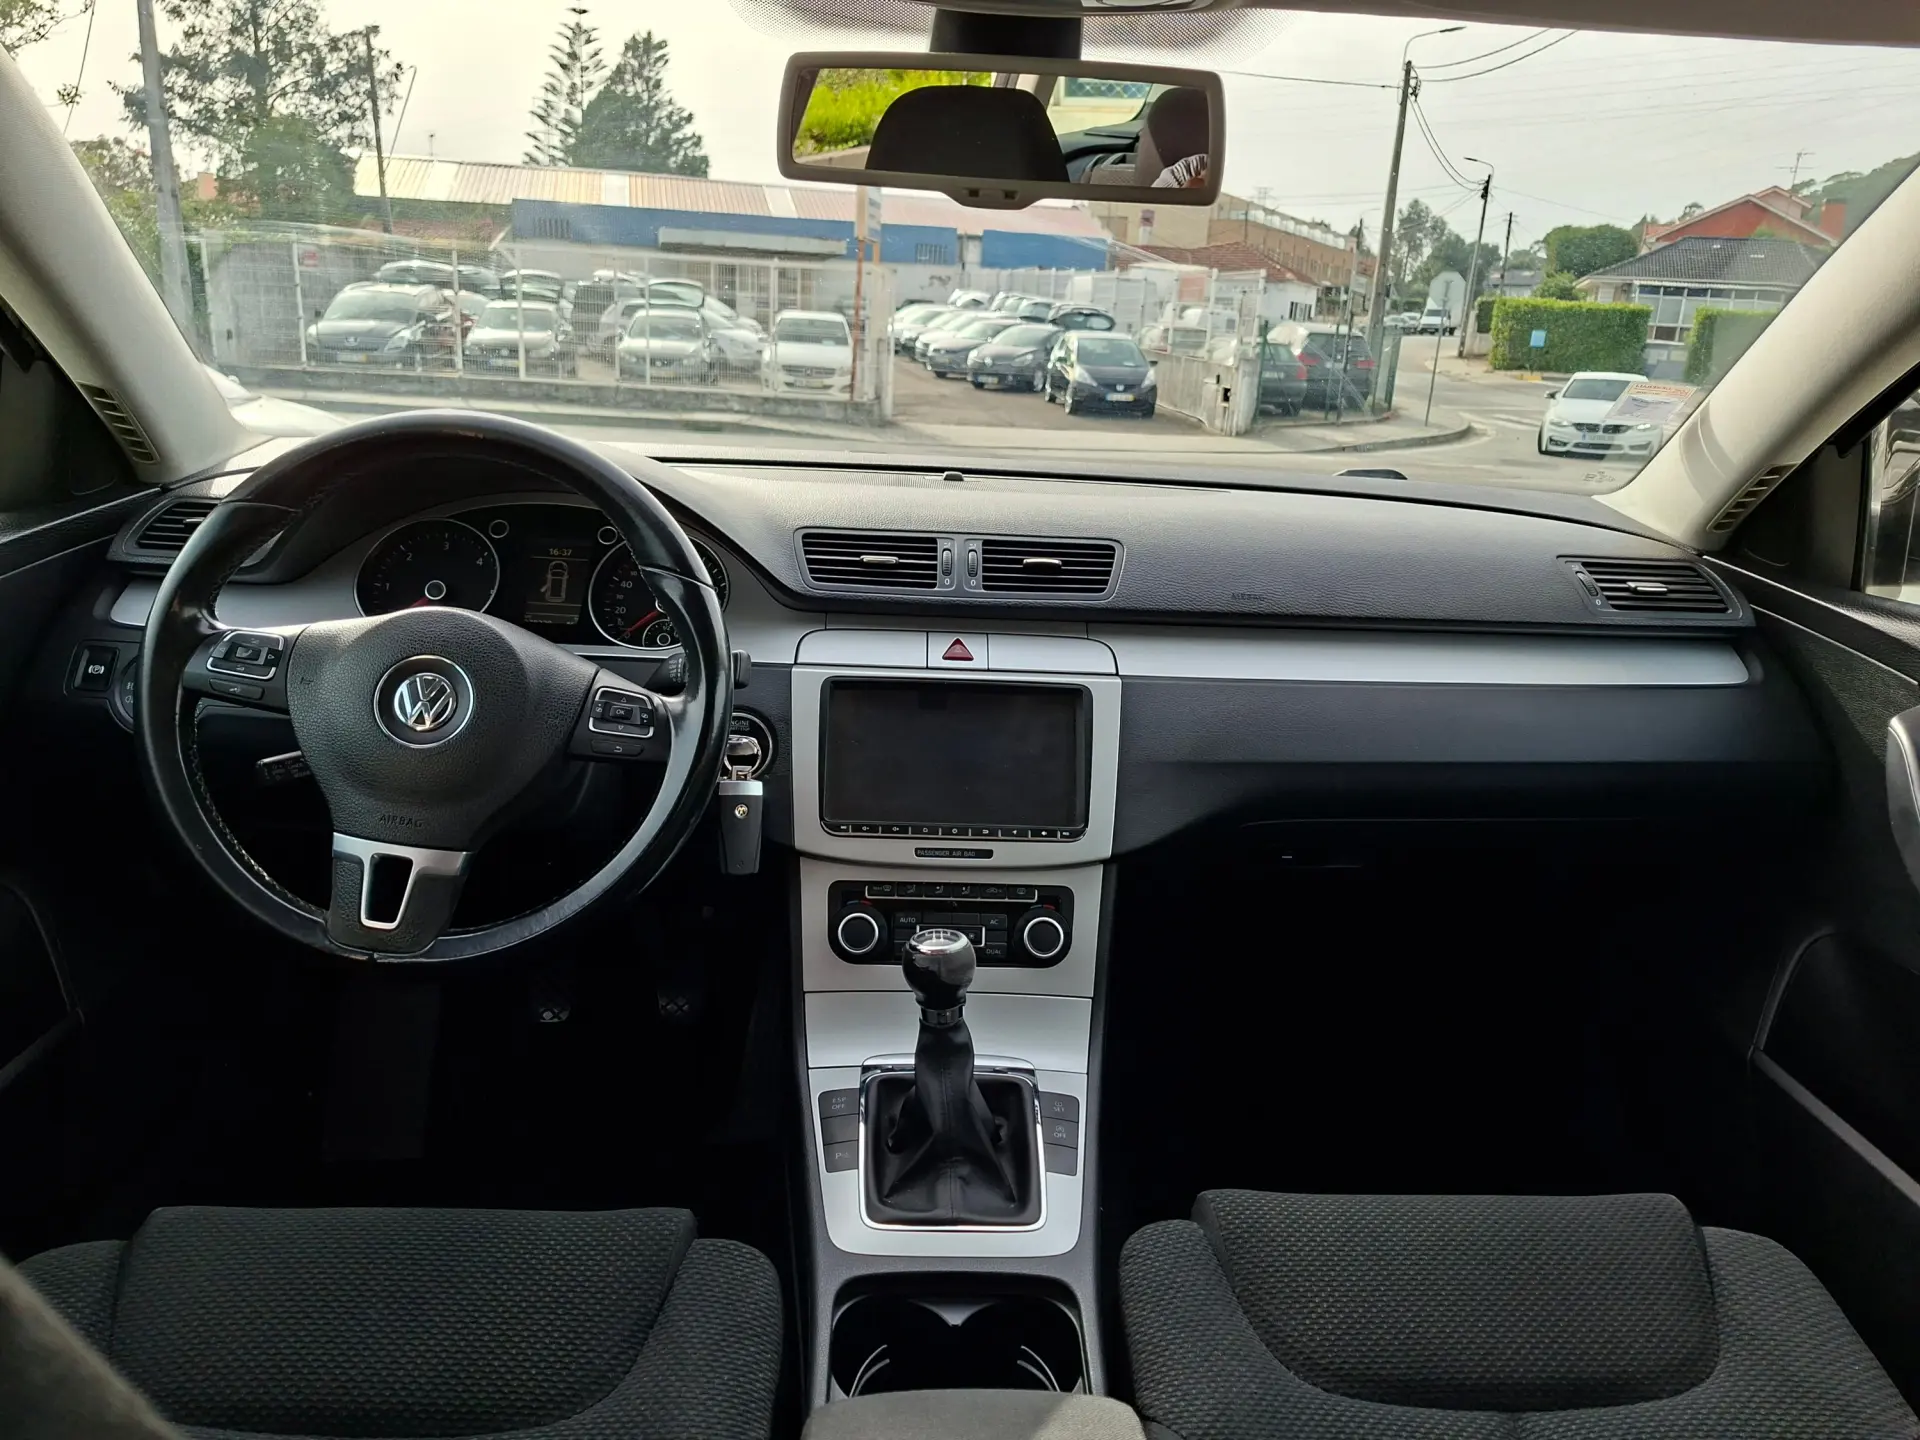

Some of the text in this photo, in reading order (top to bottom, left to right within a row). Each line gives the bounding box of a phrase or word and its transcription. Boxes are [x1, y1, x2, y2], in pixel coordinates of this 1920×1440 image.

[549, 548, 572, 556] 16:37
[620, 580, 633, 589] 40
[614, 606, 627, 615] 20
[379, 814, 423, 828] AIRBAG
